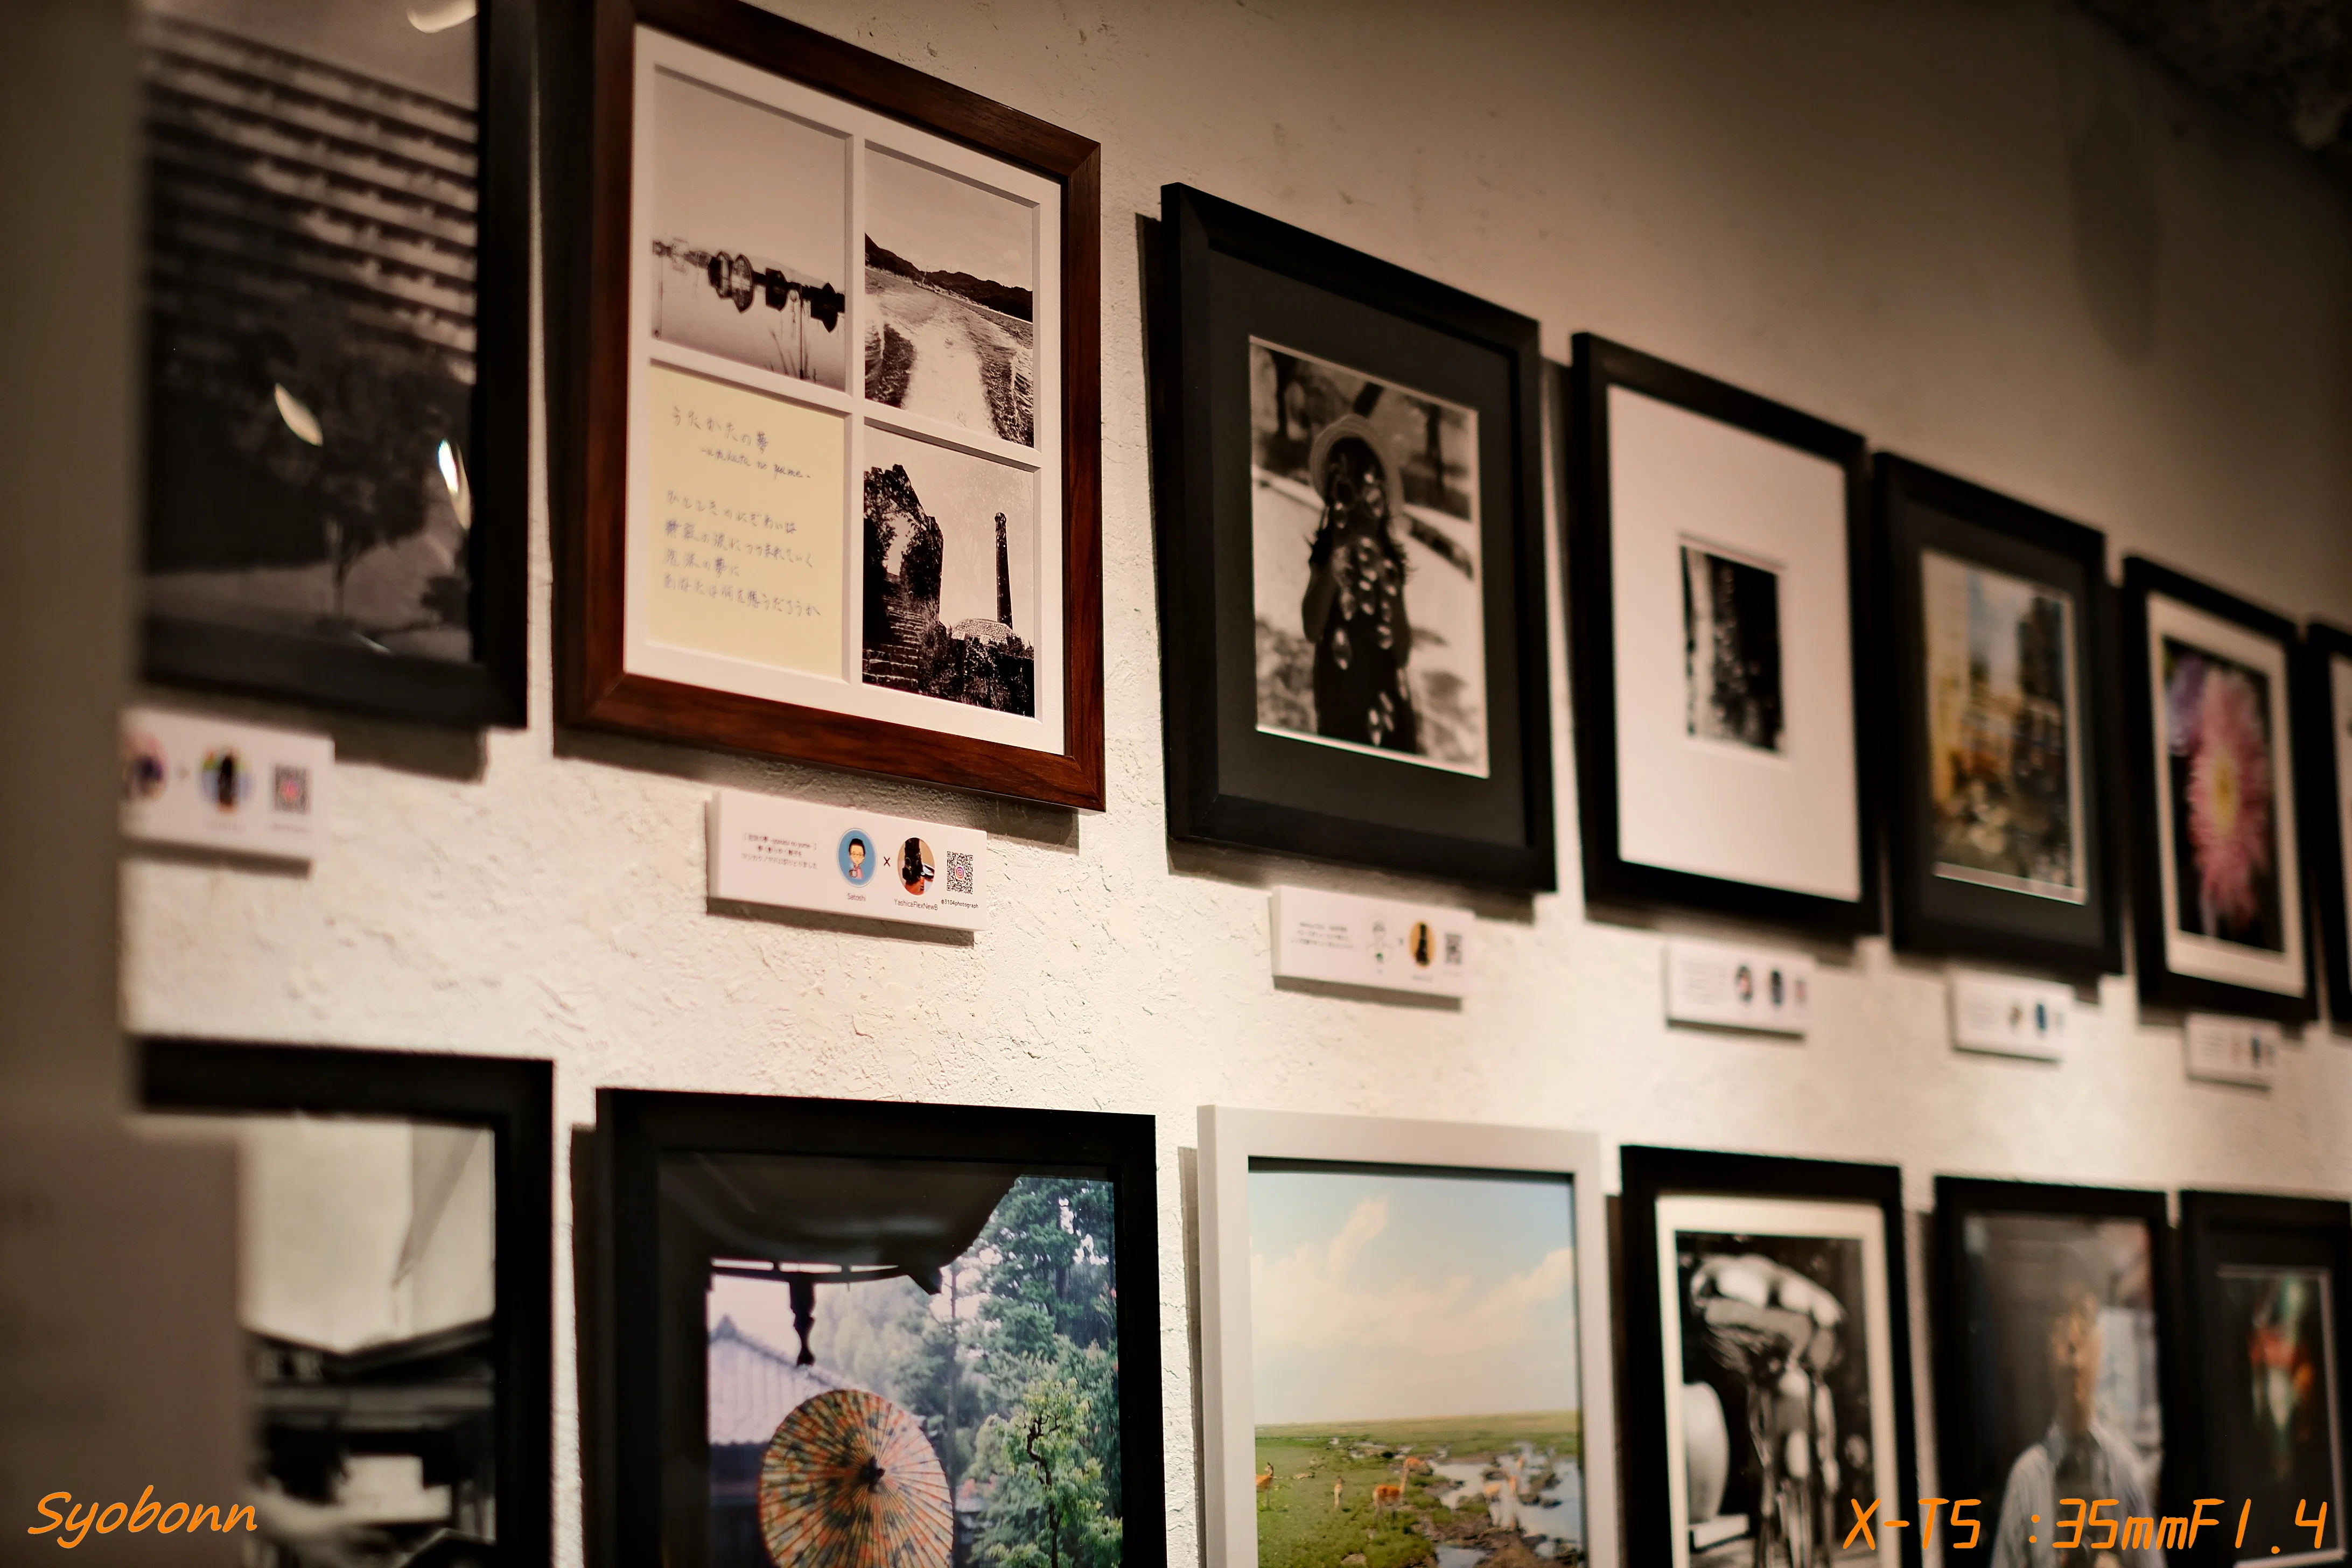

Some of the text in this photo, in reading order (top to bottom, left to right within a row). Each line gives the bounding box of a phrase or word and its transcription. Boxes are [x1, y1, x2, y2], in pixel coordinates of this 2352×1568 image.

[673, 405, 769, 454] うたかたの夢
[756, 460, 768, 470] no
[847, 893, 867, 902] Satoshi
[894, 898, 939, 911] YashicaFlexNewB
[941, 899, 979, 909] @3104photograph
